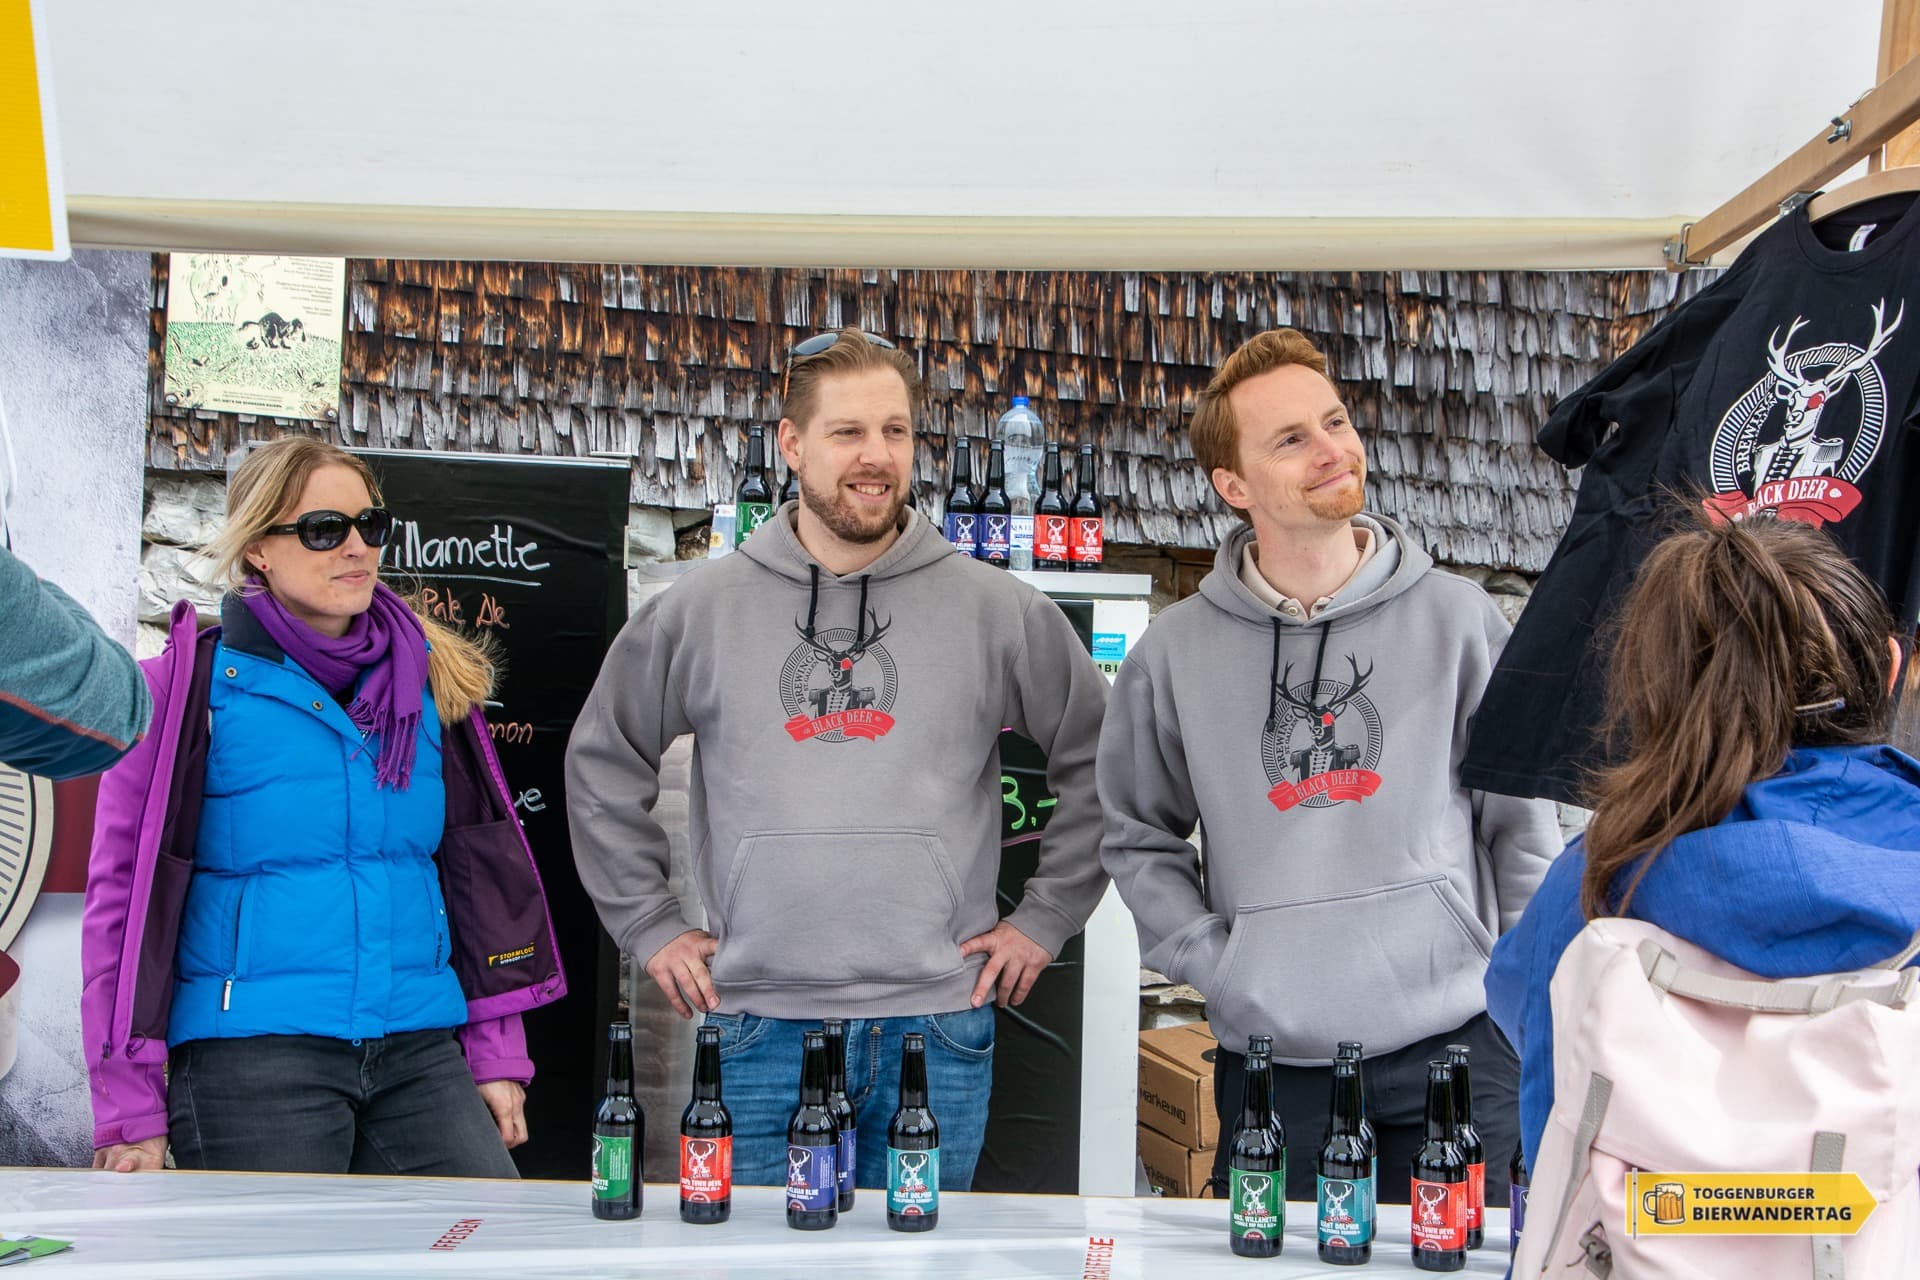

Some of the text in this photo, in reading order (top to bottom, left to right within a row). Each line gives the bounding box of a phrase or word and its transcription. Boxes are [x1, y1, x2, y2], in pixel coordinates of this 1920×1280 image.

[1736, 392, 1774, 474] BREWING
[1787, 479, 1828, 501] DEER
[422, 587, 465, 625] Pale
[794, 655, 815, 704] BREWING
[811, 711, 873, 734] BLACK DEER
[1276, 713, 1294, 771] BREWING
[1294, 771, 1359, 800] BLACK DEER
